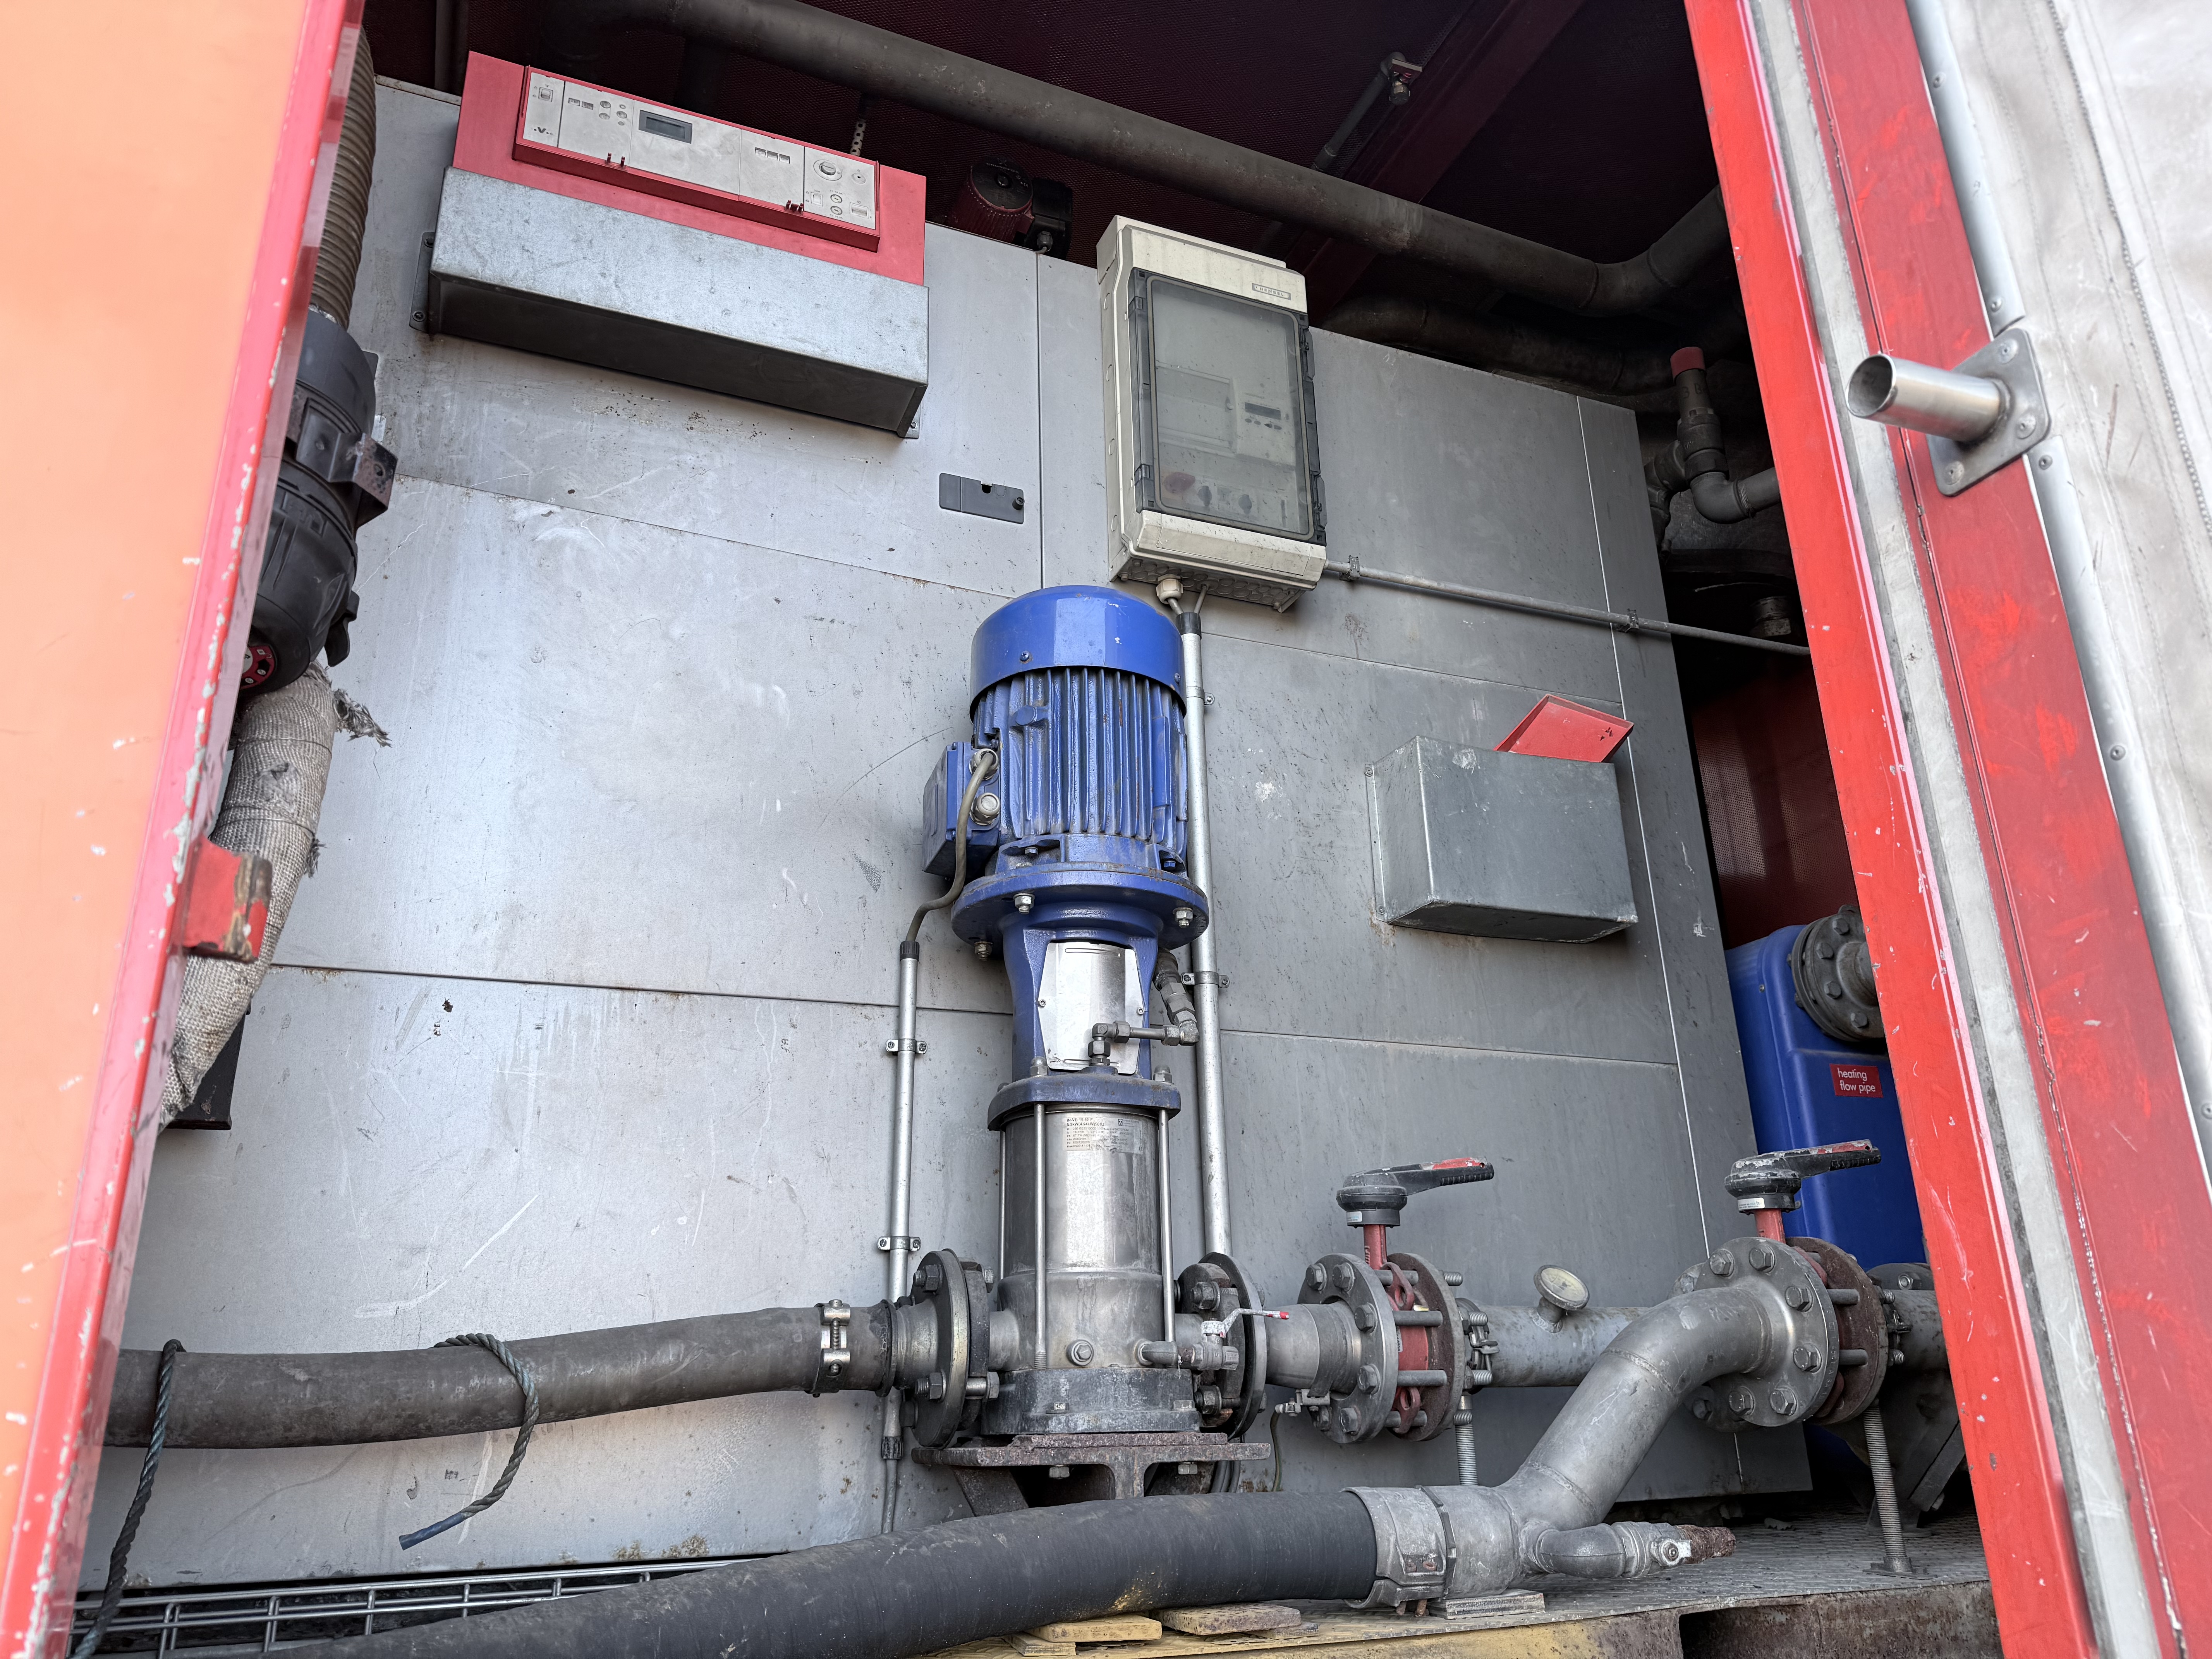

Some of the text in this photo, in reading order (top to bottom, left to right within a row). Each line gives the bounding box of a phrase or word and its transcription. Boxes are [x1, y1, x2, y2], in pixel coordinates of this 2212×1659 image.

[1259, 287, 1283, 296] HENSEL
[1837, 1067, 1867, 1081] heating
[1840, 1080, 1876, 1094] flow pipe
